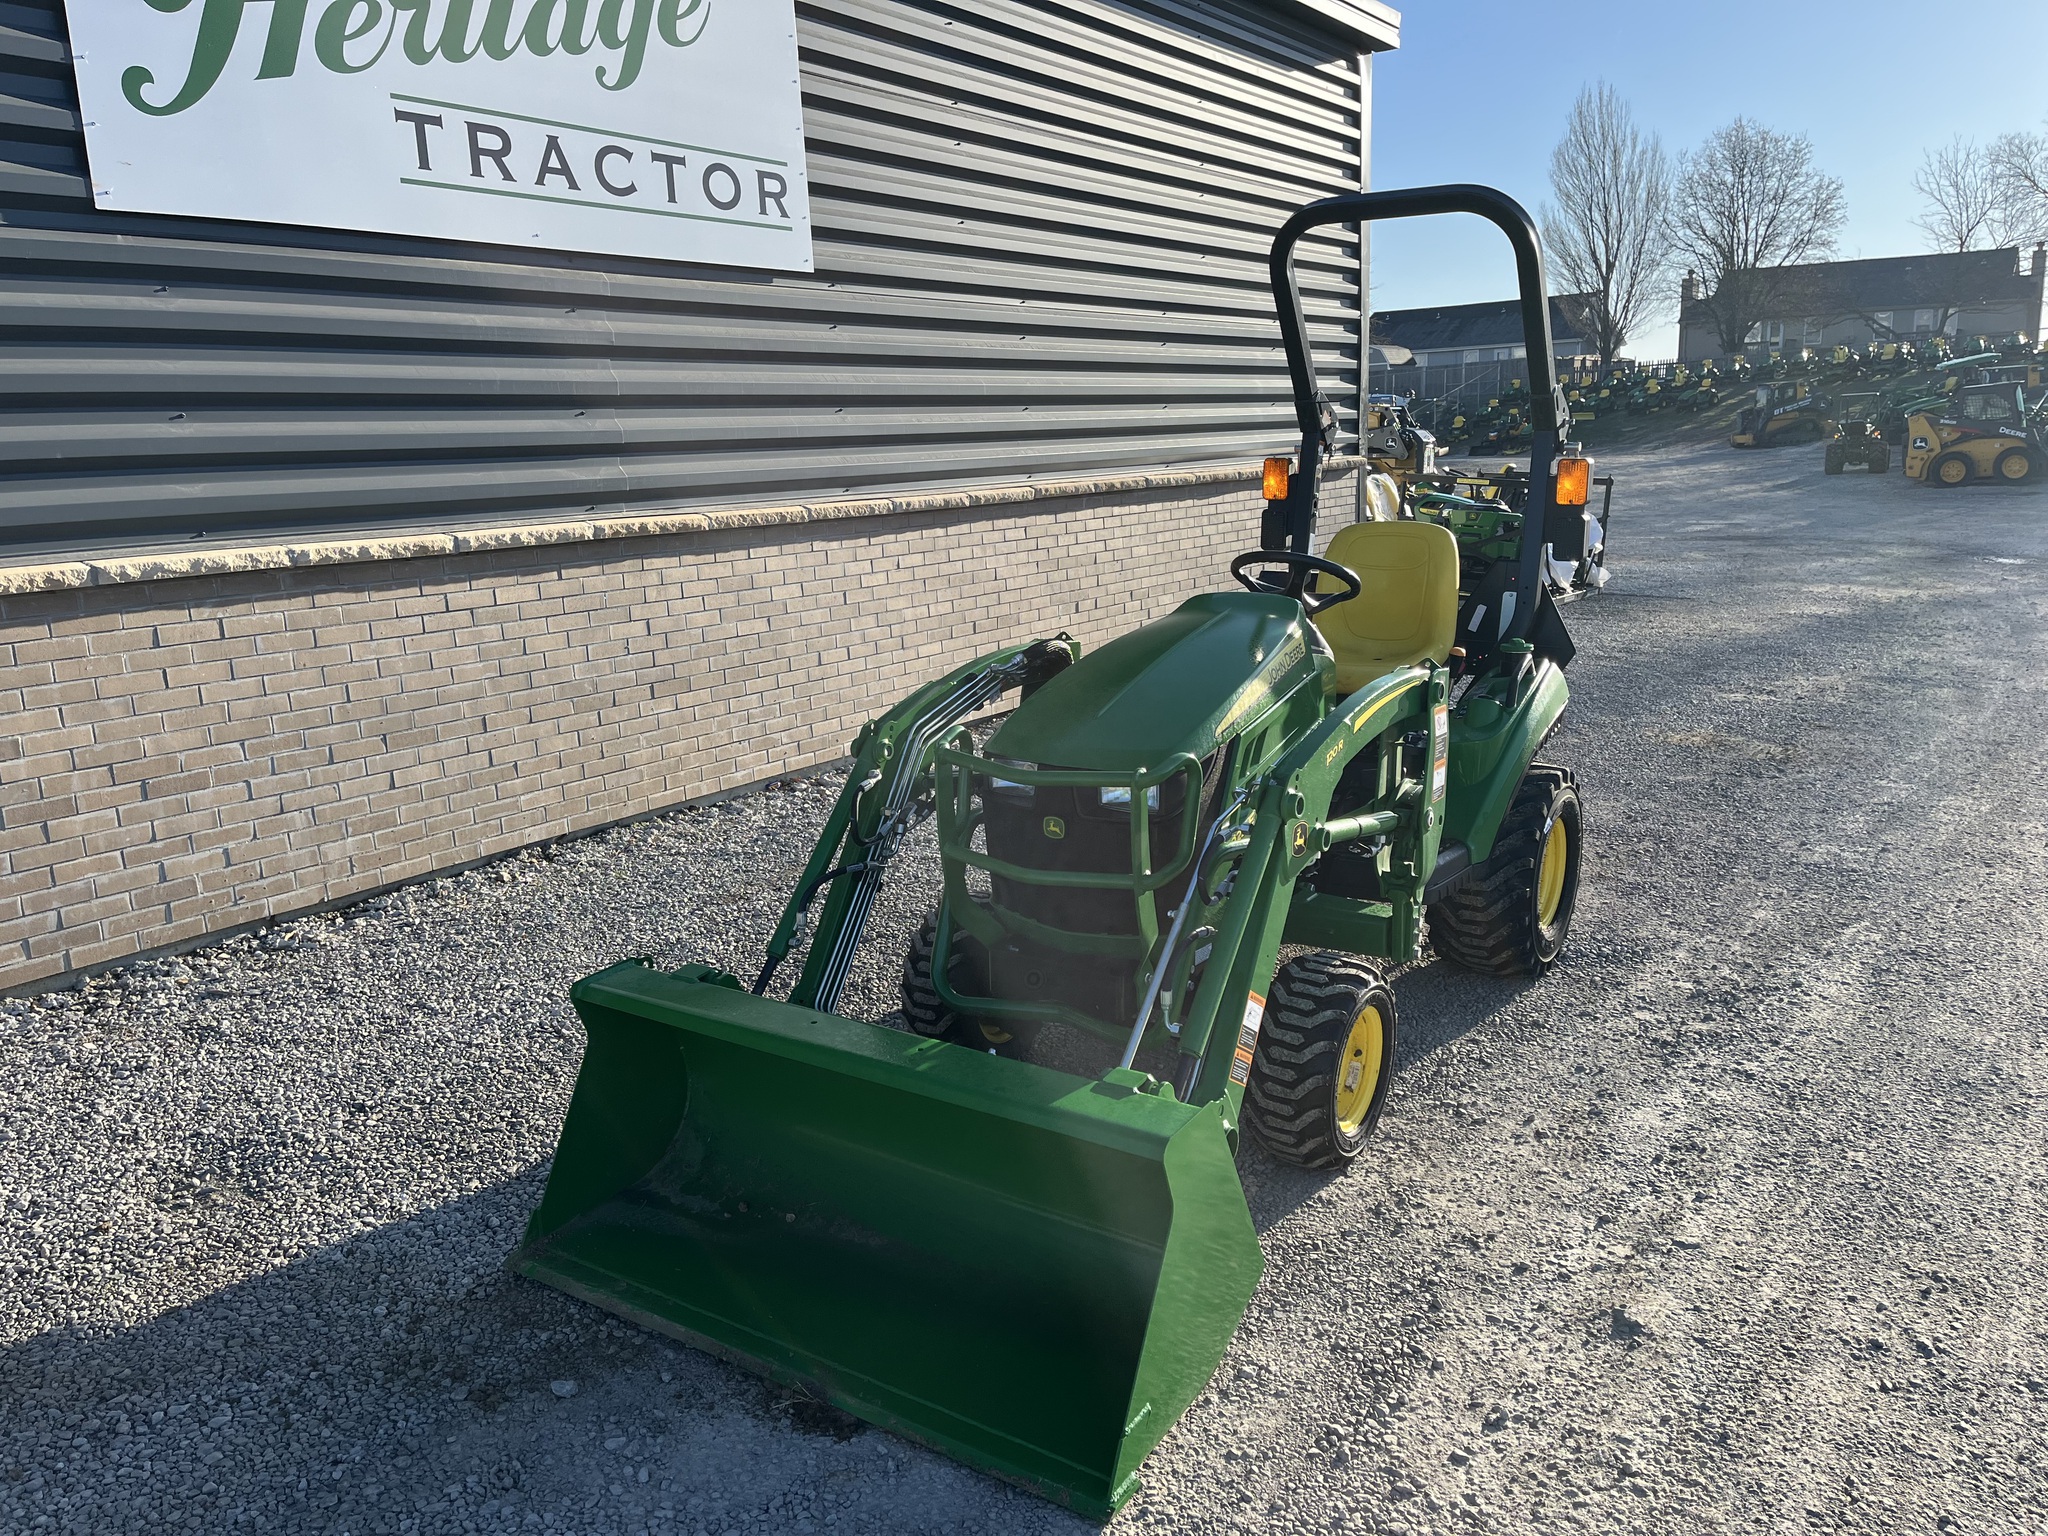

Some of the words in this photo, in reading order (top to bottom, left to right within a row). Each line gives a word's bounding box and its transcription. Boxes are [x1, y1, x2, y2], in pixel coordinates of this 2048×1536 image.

[394, 107, 790, 218] TRACTOR
[1999, 426, 2027, 438] DEERE
[1268, 660, 1287, 686] JOHN
[1284, 643, 1305, 669] DEERE
